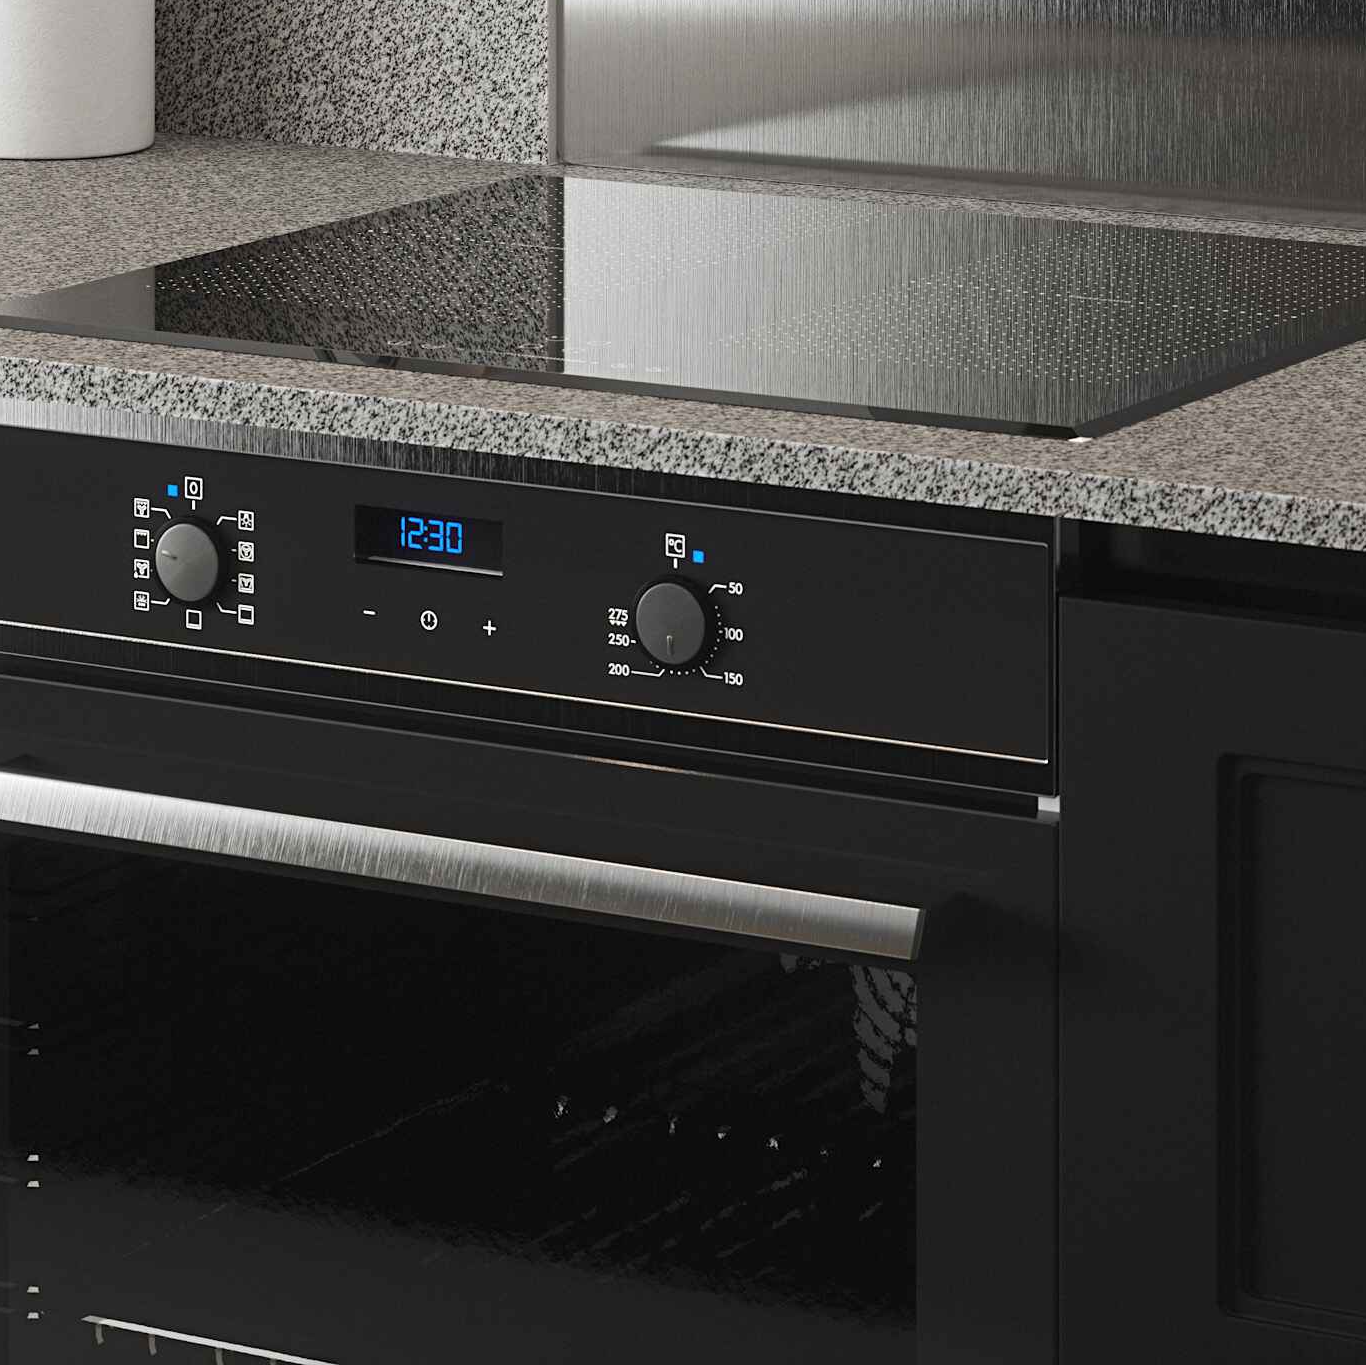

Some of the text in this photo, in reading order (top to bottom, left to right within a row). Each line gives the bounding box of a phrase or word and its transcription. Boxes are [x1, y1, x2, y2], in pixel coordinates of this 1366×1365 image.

[400, 516, 463, 554] 12:30
[728, 582, 744, 596] 50
[608, 608, 629, 621] 275
[608, 633, 630, 647] 250
[724, 627, 744, 642] 100
[608, 663, 630, 677] 200
[724, 672, 744, 686] 150
